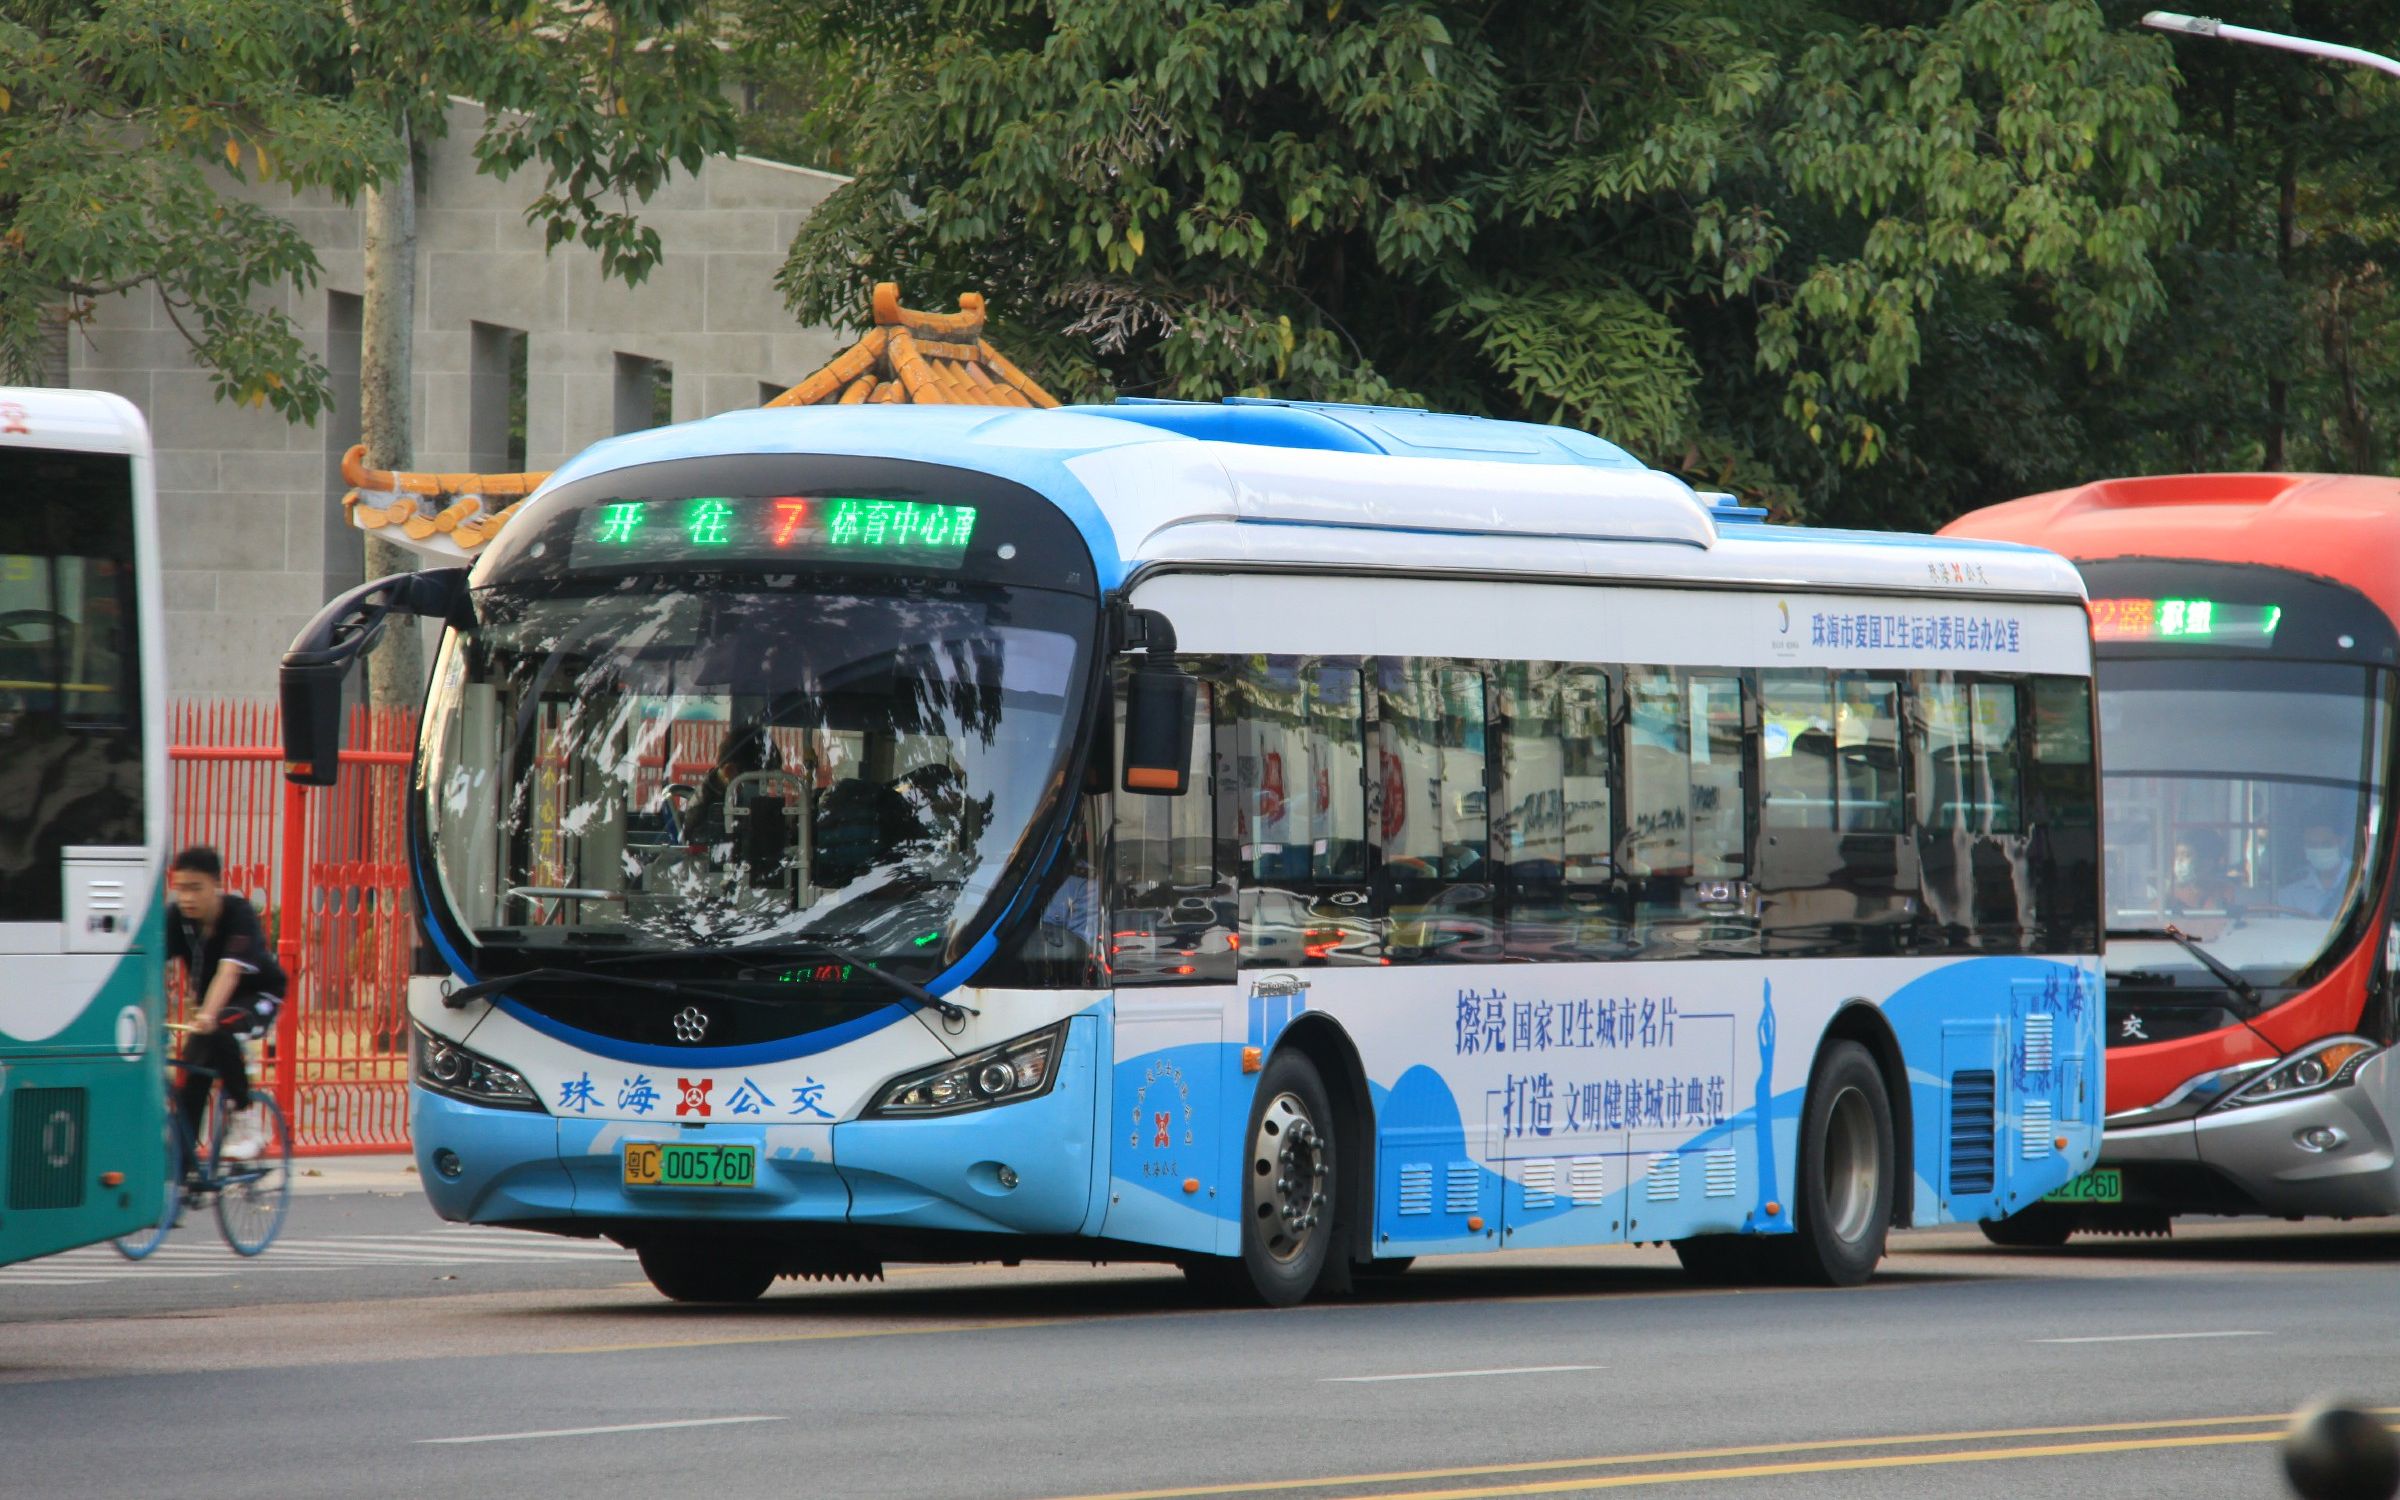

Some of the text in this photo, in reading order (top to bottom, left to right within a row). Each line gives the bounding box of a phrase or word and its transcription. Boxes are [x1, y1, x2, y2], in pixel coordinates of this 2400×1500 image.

[598, 500, 733, 543] 开往
[775, 501, 803, 546] 7
[1811, 613, 2020, 654] 珠海市爱国卫生运动委员会办公室
[2121, 1014, 2149, 1039] 交
[558, 1071, 836, 1119] 珠海 公交
